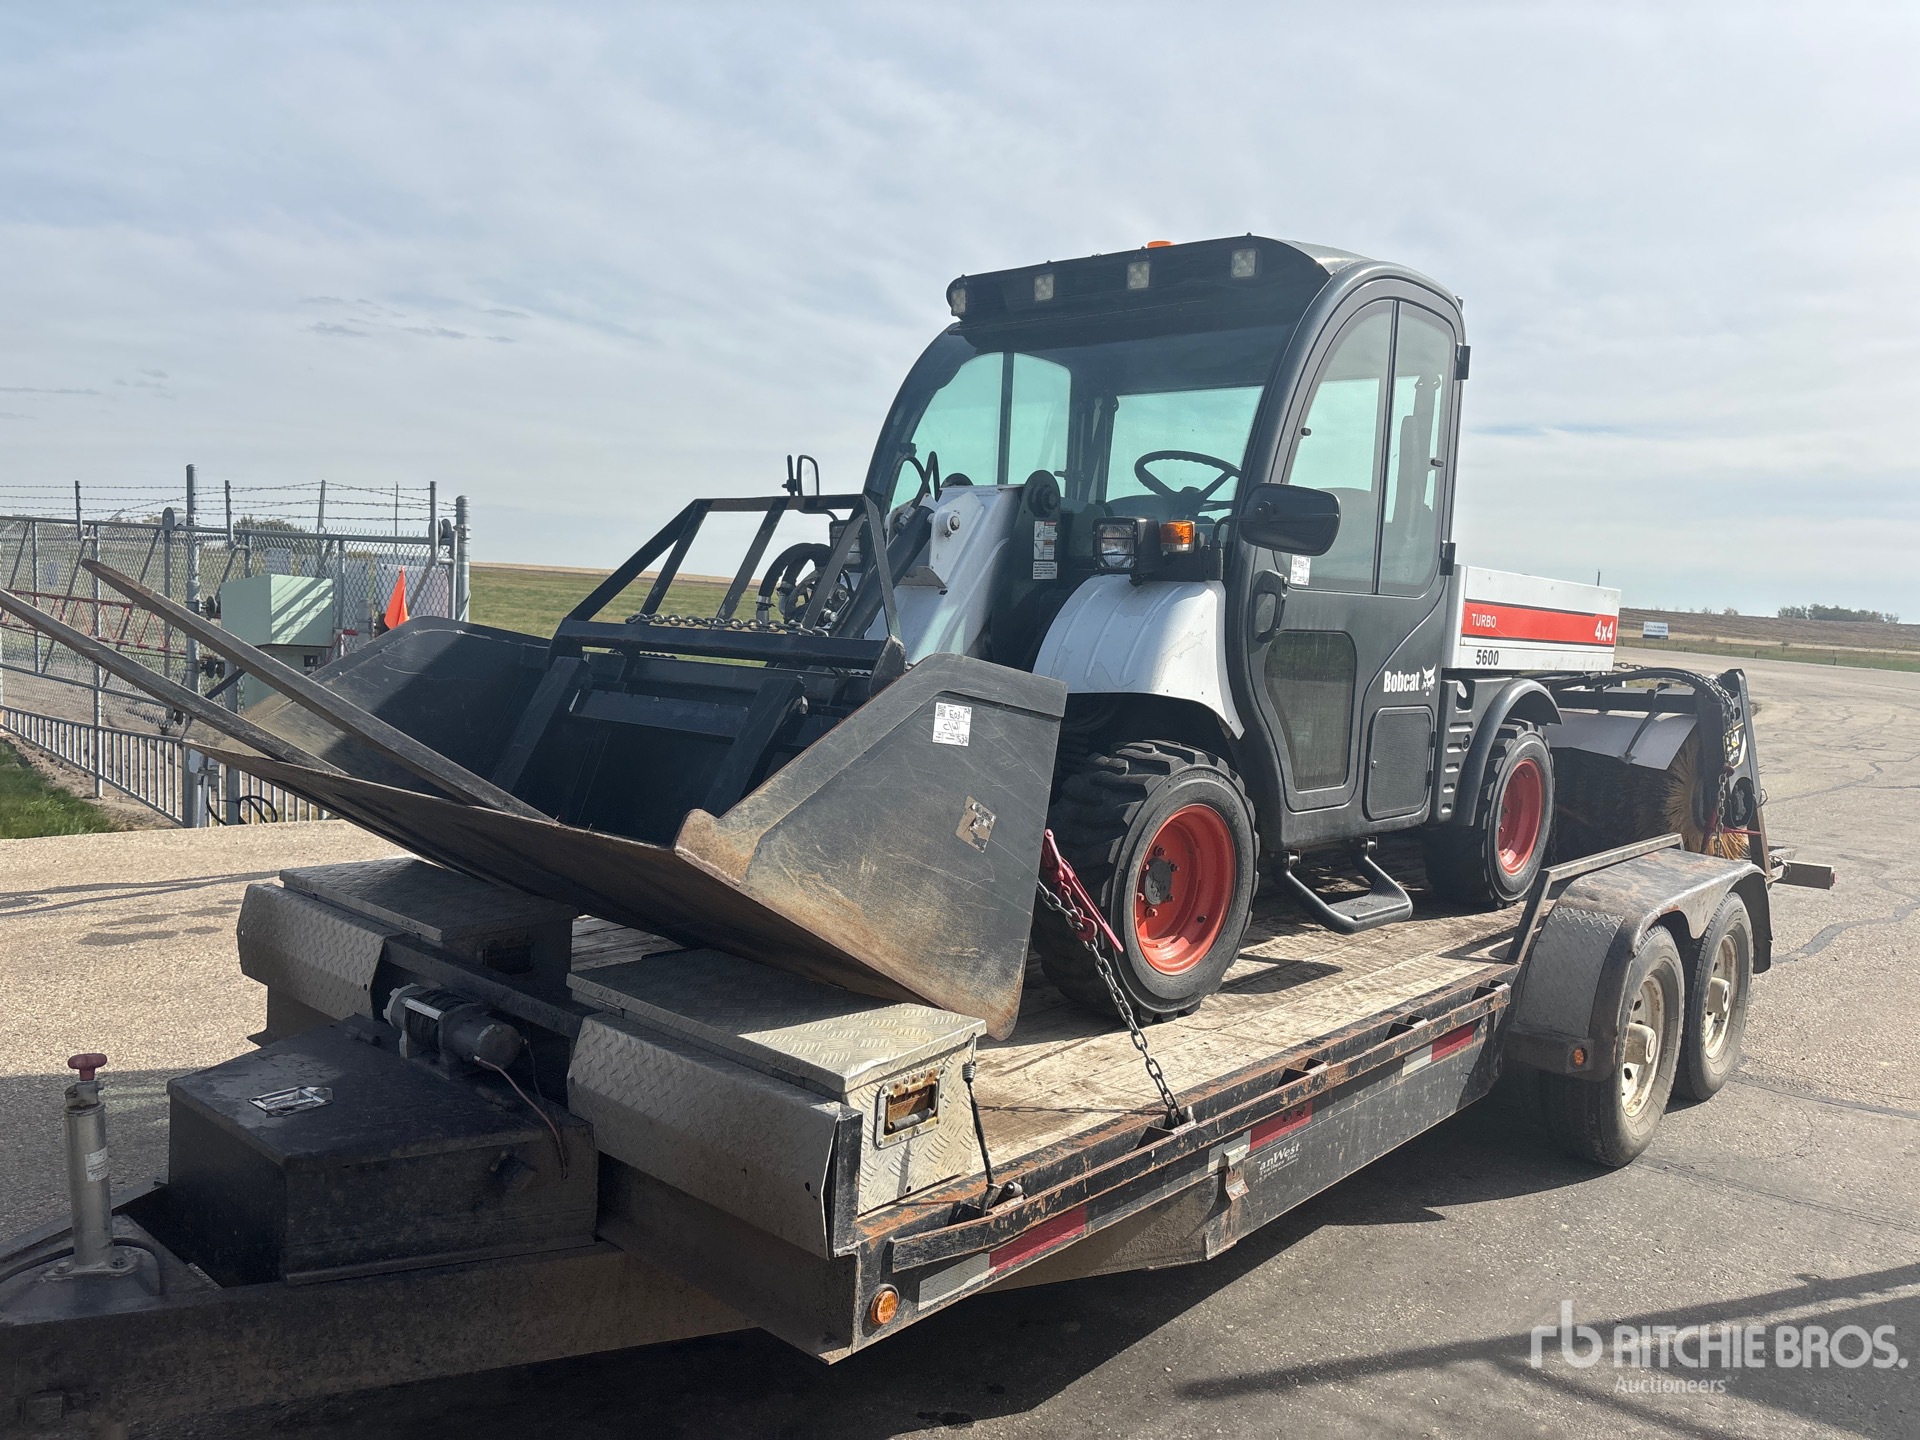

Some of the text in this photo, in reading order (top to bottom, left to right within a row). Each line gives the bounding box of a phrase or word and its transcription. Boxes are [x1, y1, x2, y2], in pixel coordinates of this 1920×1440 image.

[1471, 613, 1497, 629] TURBO
[1594, 619, 1614, 641] 4x4
[1475, 649, 1499, 666] 5600
[1383, 670, 1420, 693] Bobcat
[1256, 1142, 1300, 1171] anWest
